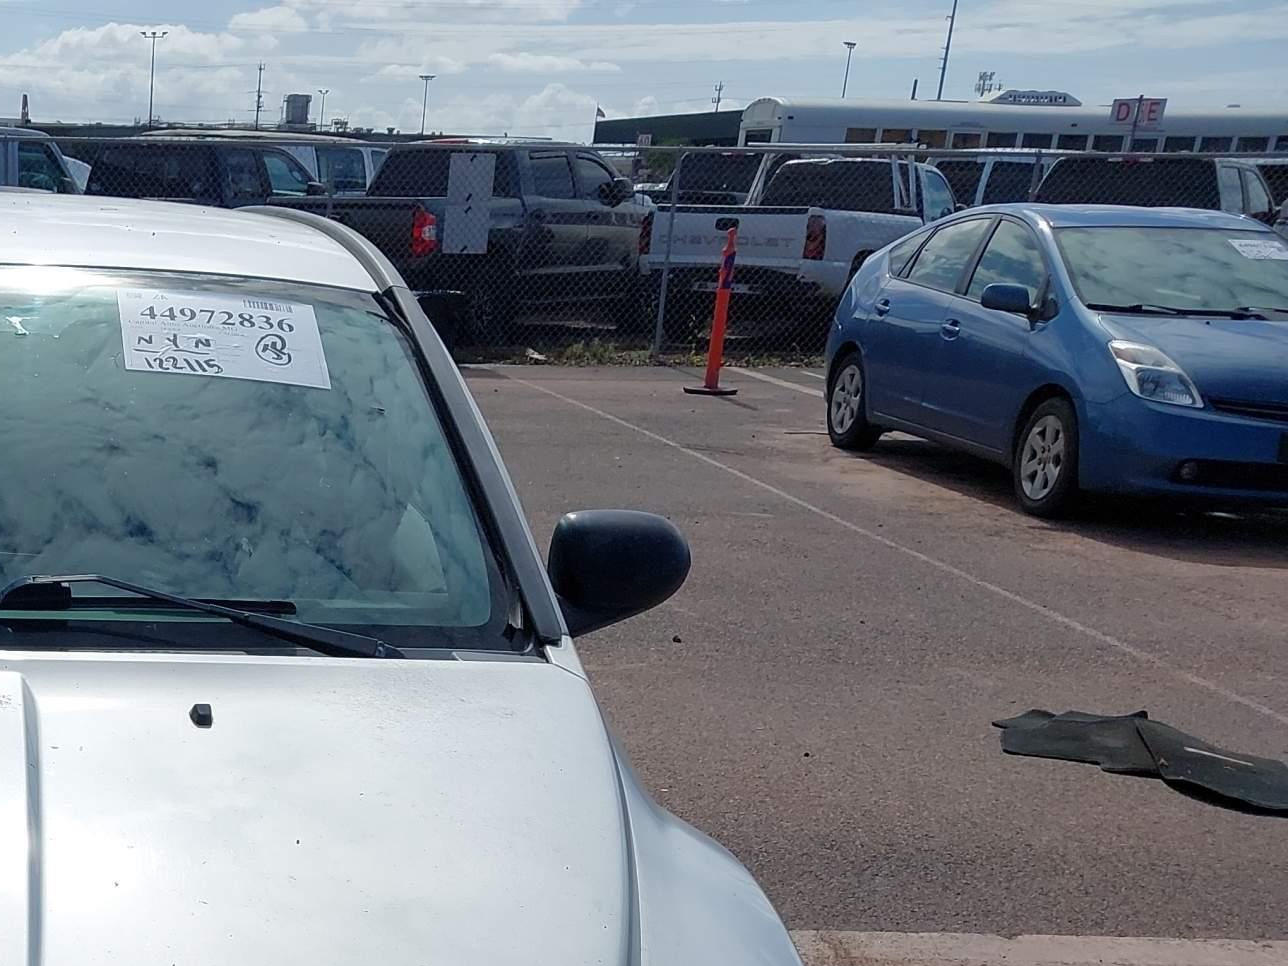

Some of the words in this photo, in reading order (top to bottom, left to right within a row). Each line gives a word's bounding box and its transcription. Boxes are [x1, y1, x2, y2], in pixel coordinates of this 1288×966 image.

[1116, 102, 1131, 121] D
[1147, 101, 1161, 121] E
[140, 305, 296, 333] 44972836
